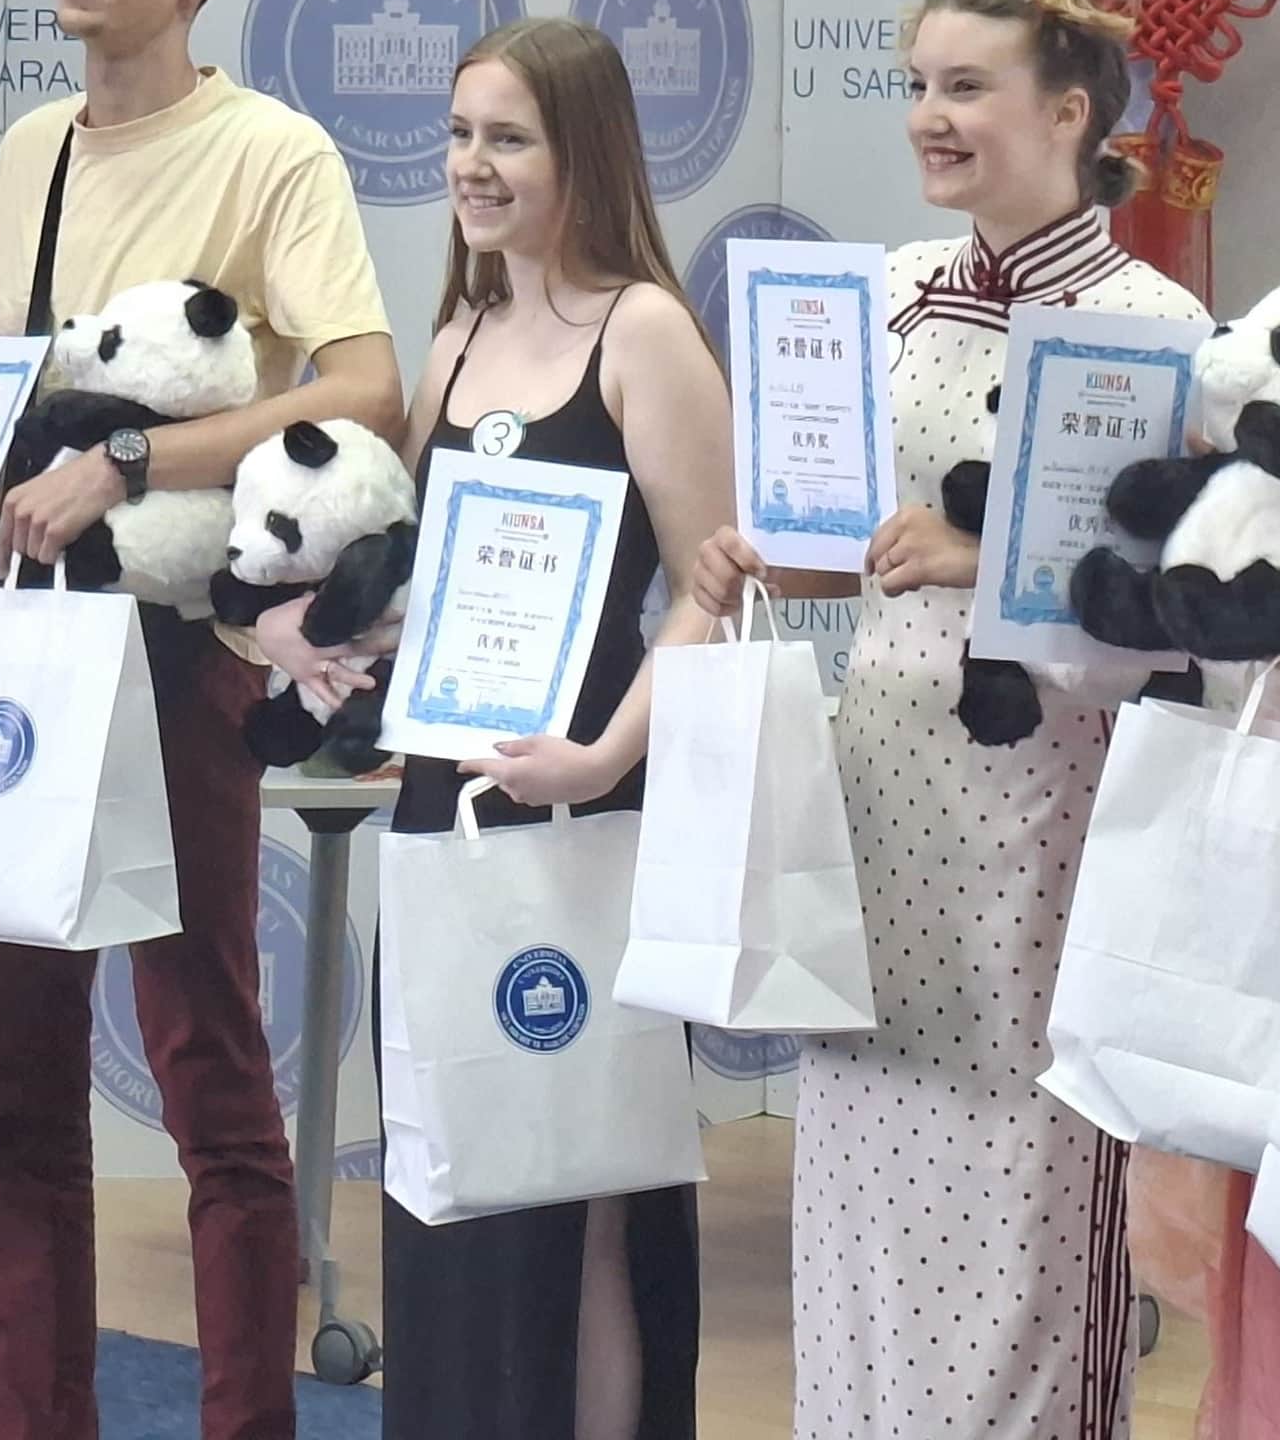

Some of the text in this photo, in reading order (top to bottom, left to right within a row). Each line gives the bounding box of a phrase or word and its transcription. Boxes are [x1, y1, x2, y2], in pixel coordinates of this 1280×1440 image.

[793, 18, 904, 50] UNIVE
[793, 66, 913, 100] U SAR
[482, 421, 511, 456] 3
[1059, 412, 1148, 441] 荣誉证书
